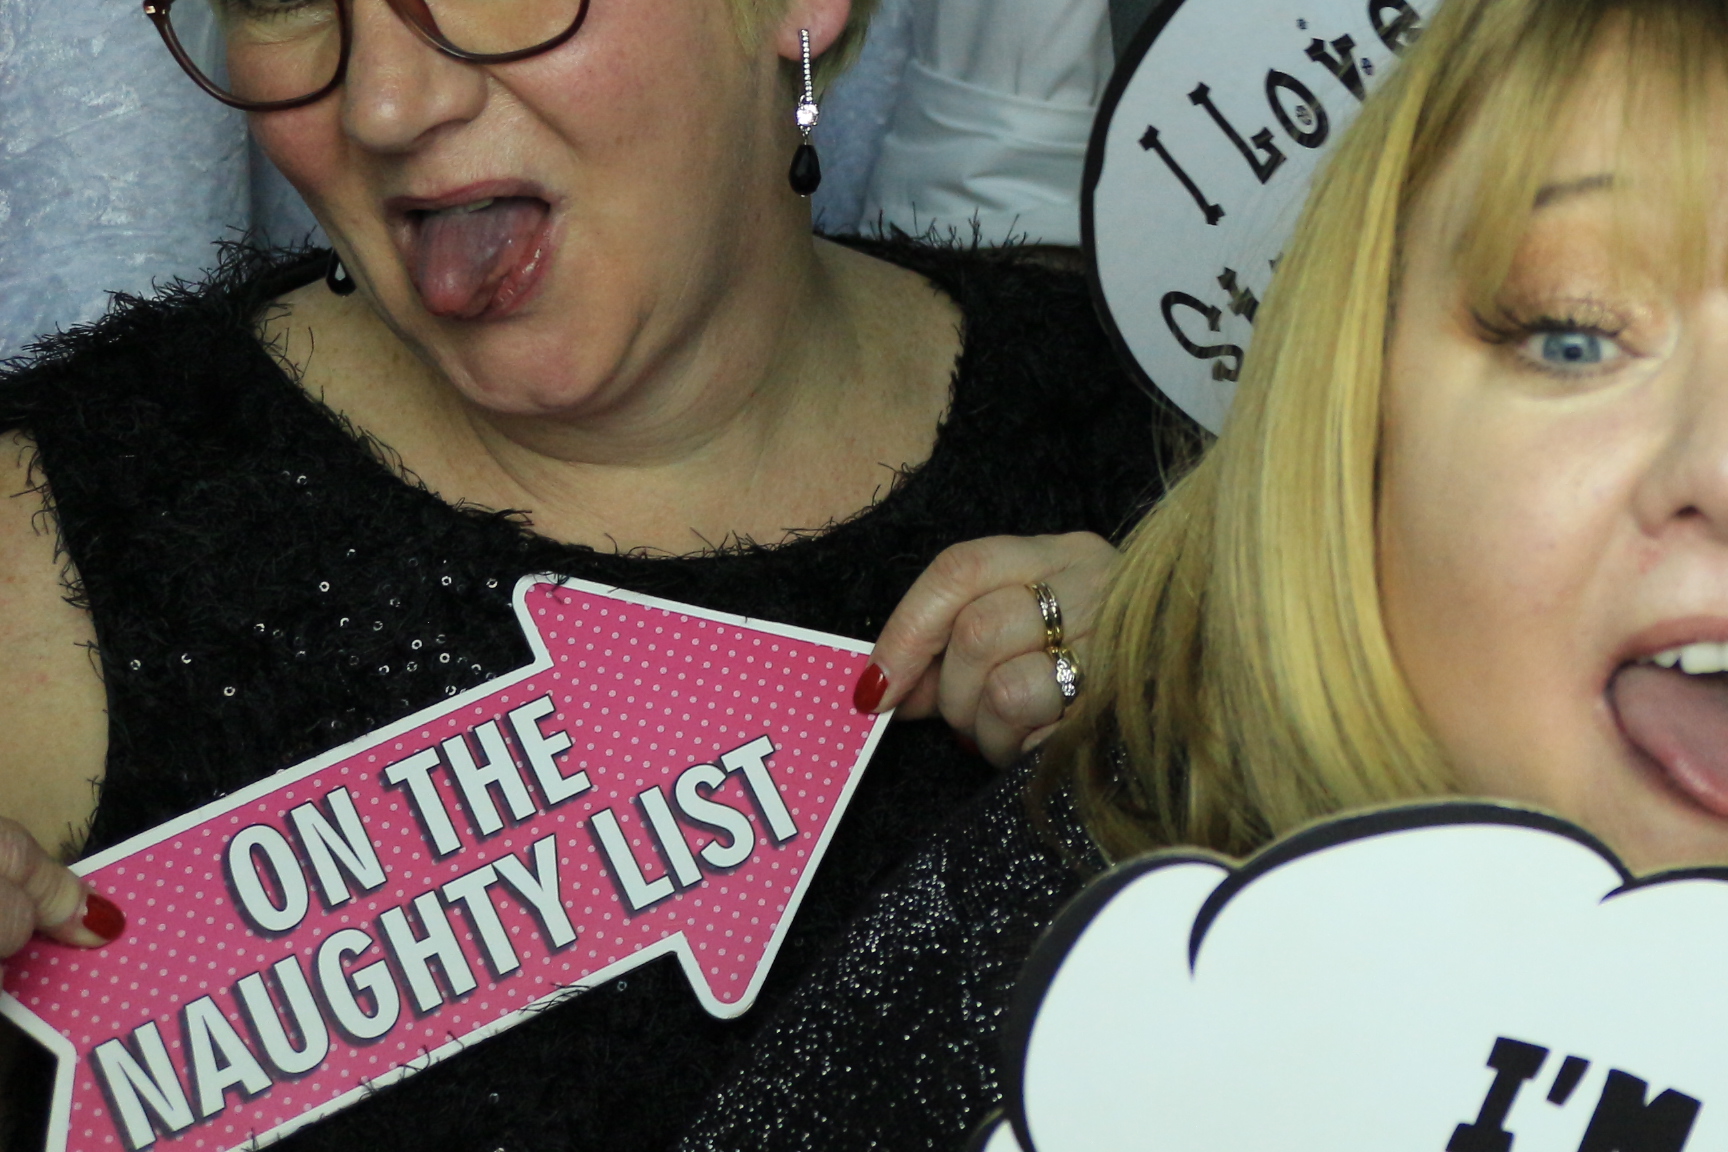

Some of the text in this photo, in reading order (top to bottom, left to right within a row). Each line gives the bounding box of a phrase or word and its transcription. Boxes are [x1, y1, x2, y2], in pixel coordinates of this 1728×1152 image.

[1138, 125, 1225, 226] I
[227, 694, 592, 933] ON THE
[94, 735, 798, 1151] NAUGHTY LIST
[1445, 1036, 1702, 1152] I'M
